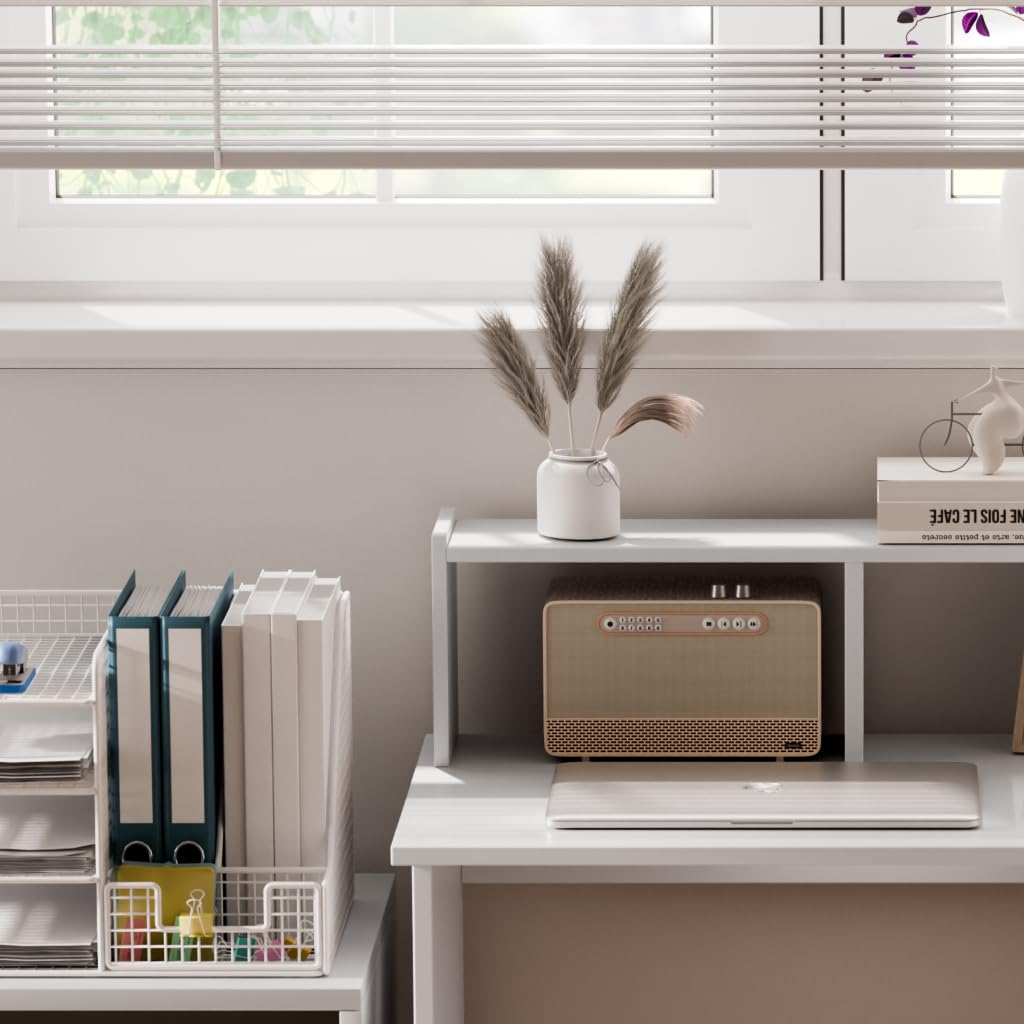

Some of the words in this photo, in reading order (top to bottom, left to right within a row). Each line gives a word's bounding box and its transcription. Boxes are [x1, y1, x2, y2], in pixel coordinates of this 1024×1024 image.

[928, 508, 961, 527] CAFÉ
[963, 508, 978, 524] LE
[979, 508, 1007, 524] FOIS
[921, 534, 953, 542] secrets
[954, 533, 980, 542] petits
[980, 534, 991, 542] et
[991, 534, 1010, 542] arts
